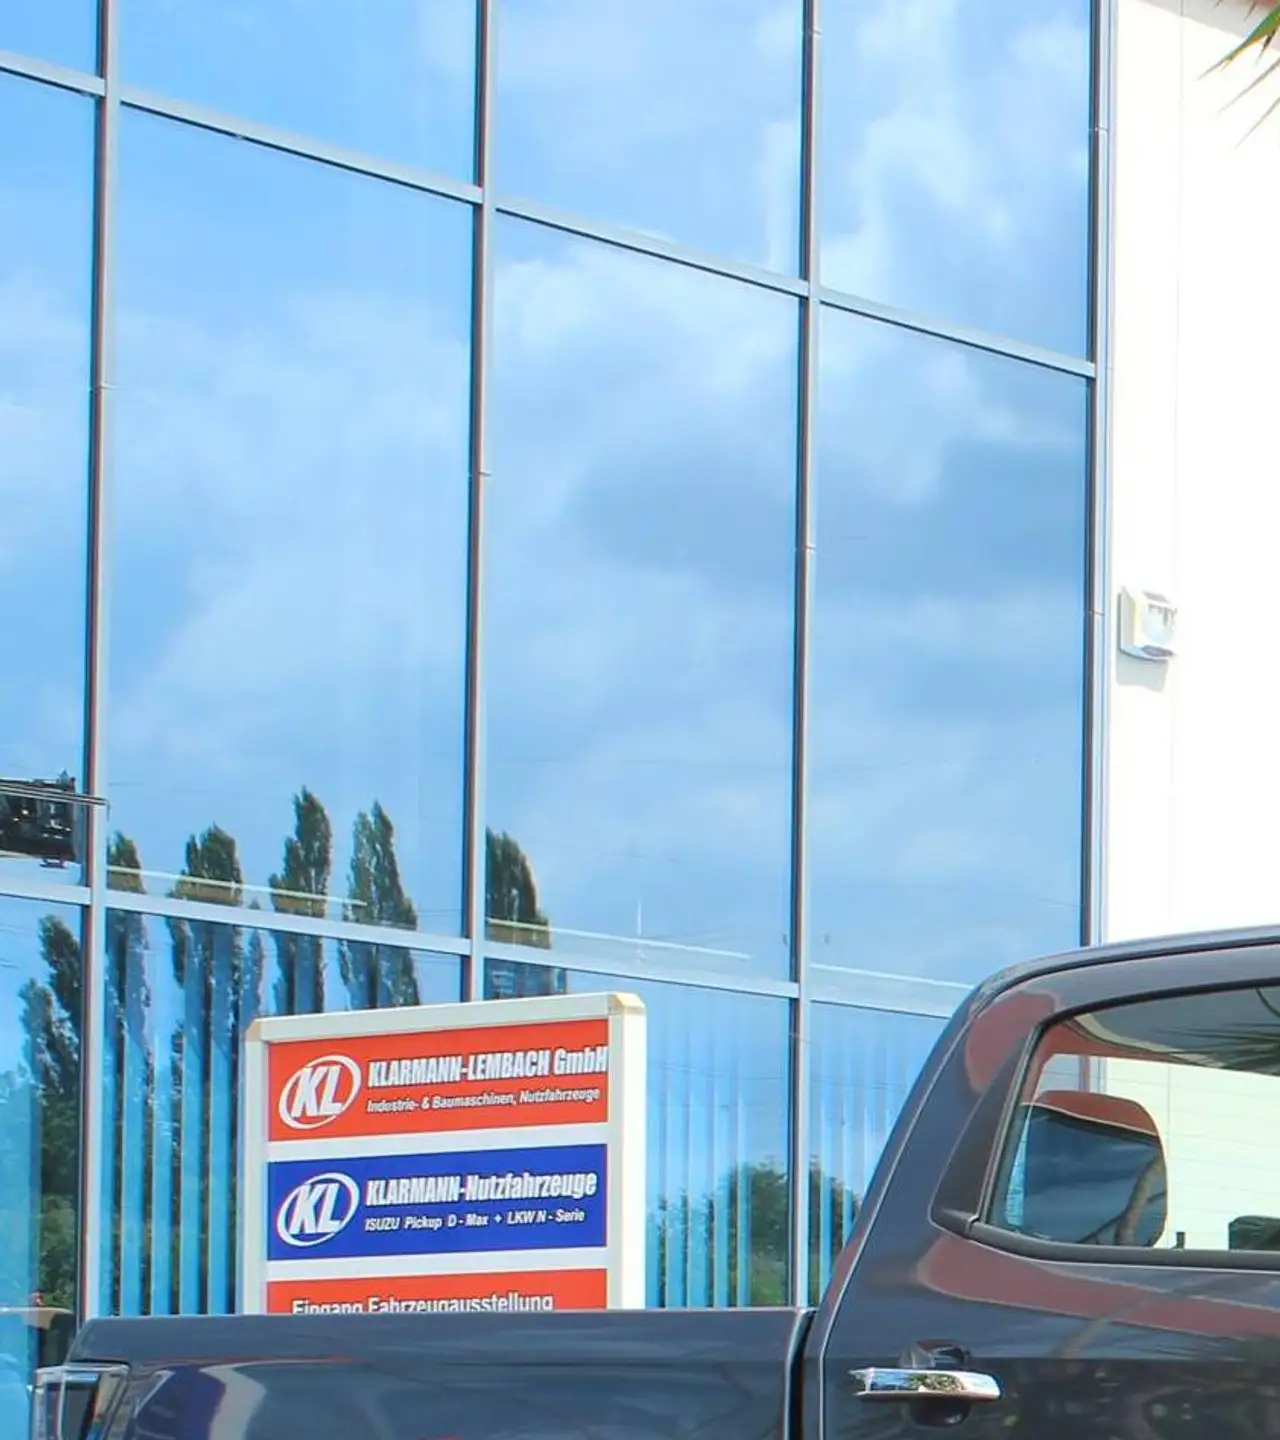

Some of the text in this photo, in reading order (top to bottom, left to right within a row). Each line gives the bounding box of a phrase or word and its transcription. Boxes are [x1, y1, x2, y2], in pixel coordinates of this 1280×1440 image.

[368, 1045, 608, 1088] KLARMANN-LEMBACH GmbH
[289, 1064, 344, 1118] KL
[366, 1097, 420, 1113] Industrie-
[431, 1091, 517, 1109] Baumaschinen,
[519, 1086, 600, 1104] Nutzfahrzeuge
[366, 1172, 598, 1206] KLARMANN-Nutzfahrzeuge
[288, 1182, 342, 1235] KL
[364, 1216, 401, 1232] ISUZU
[403, 1215, 443, 1231] Pickup
[555, 1207, 586, 1223] Serie
